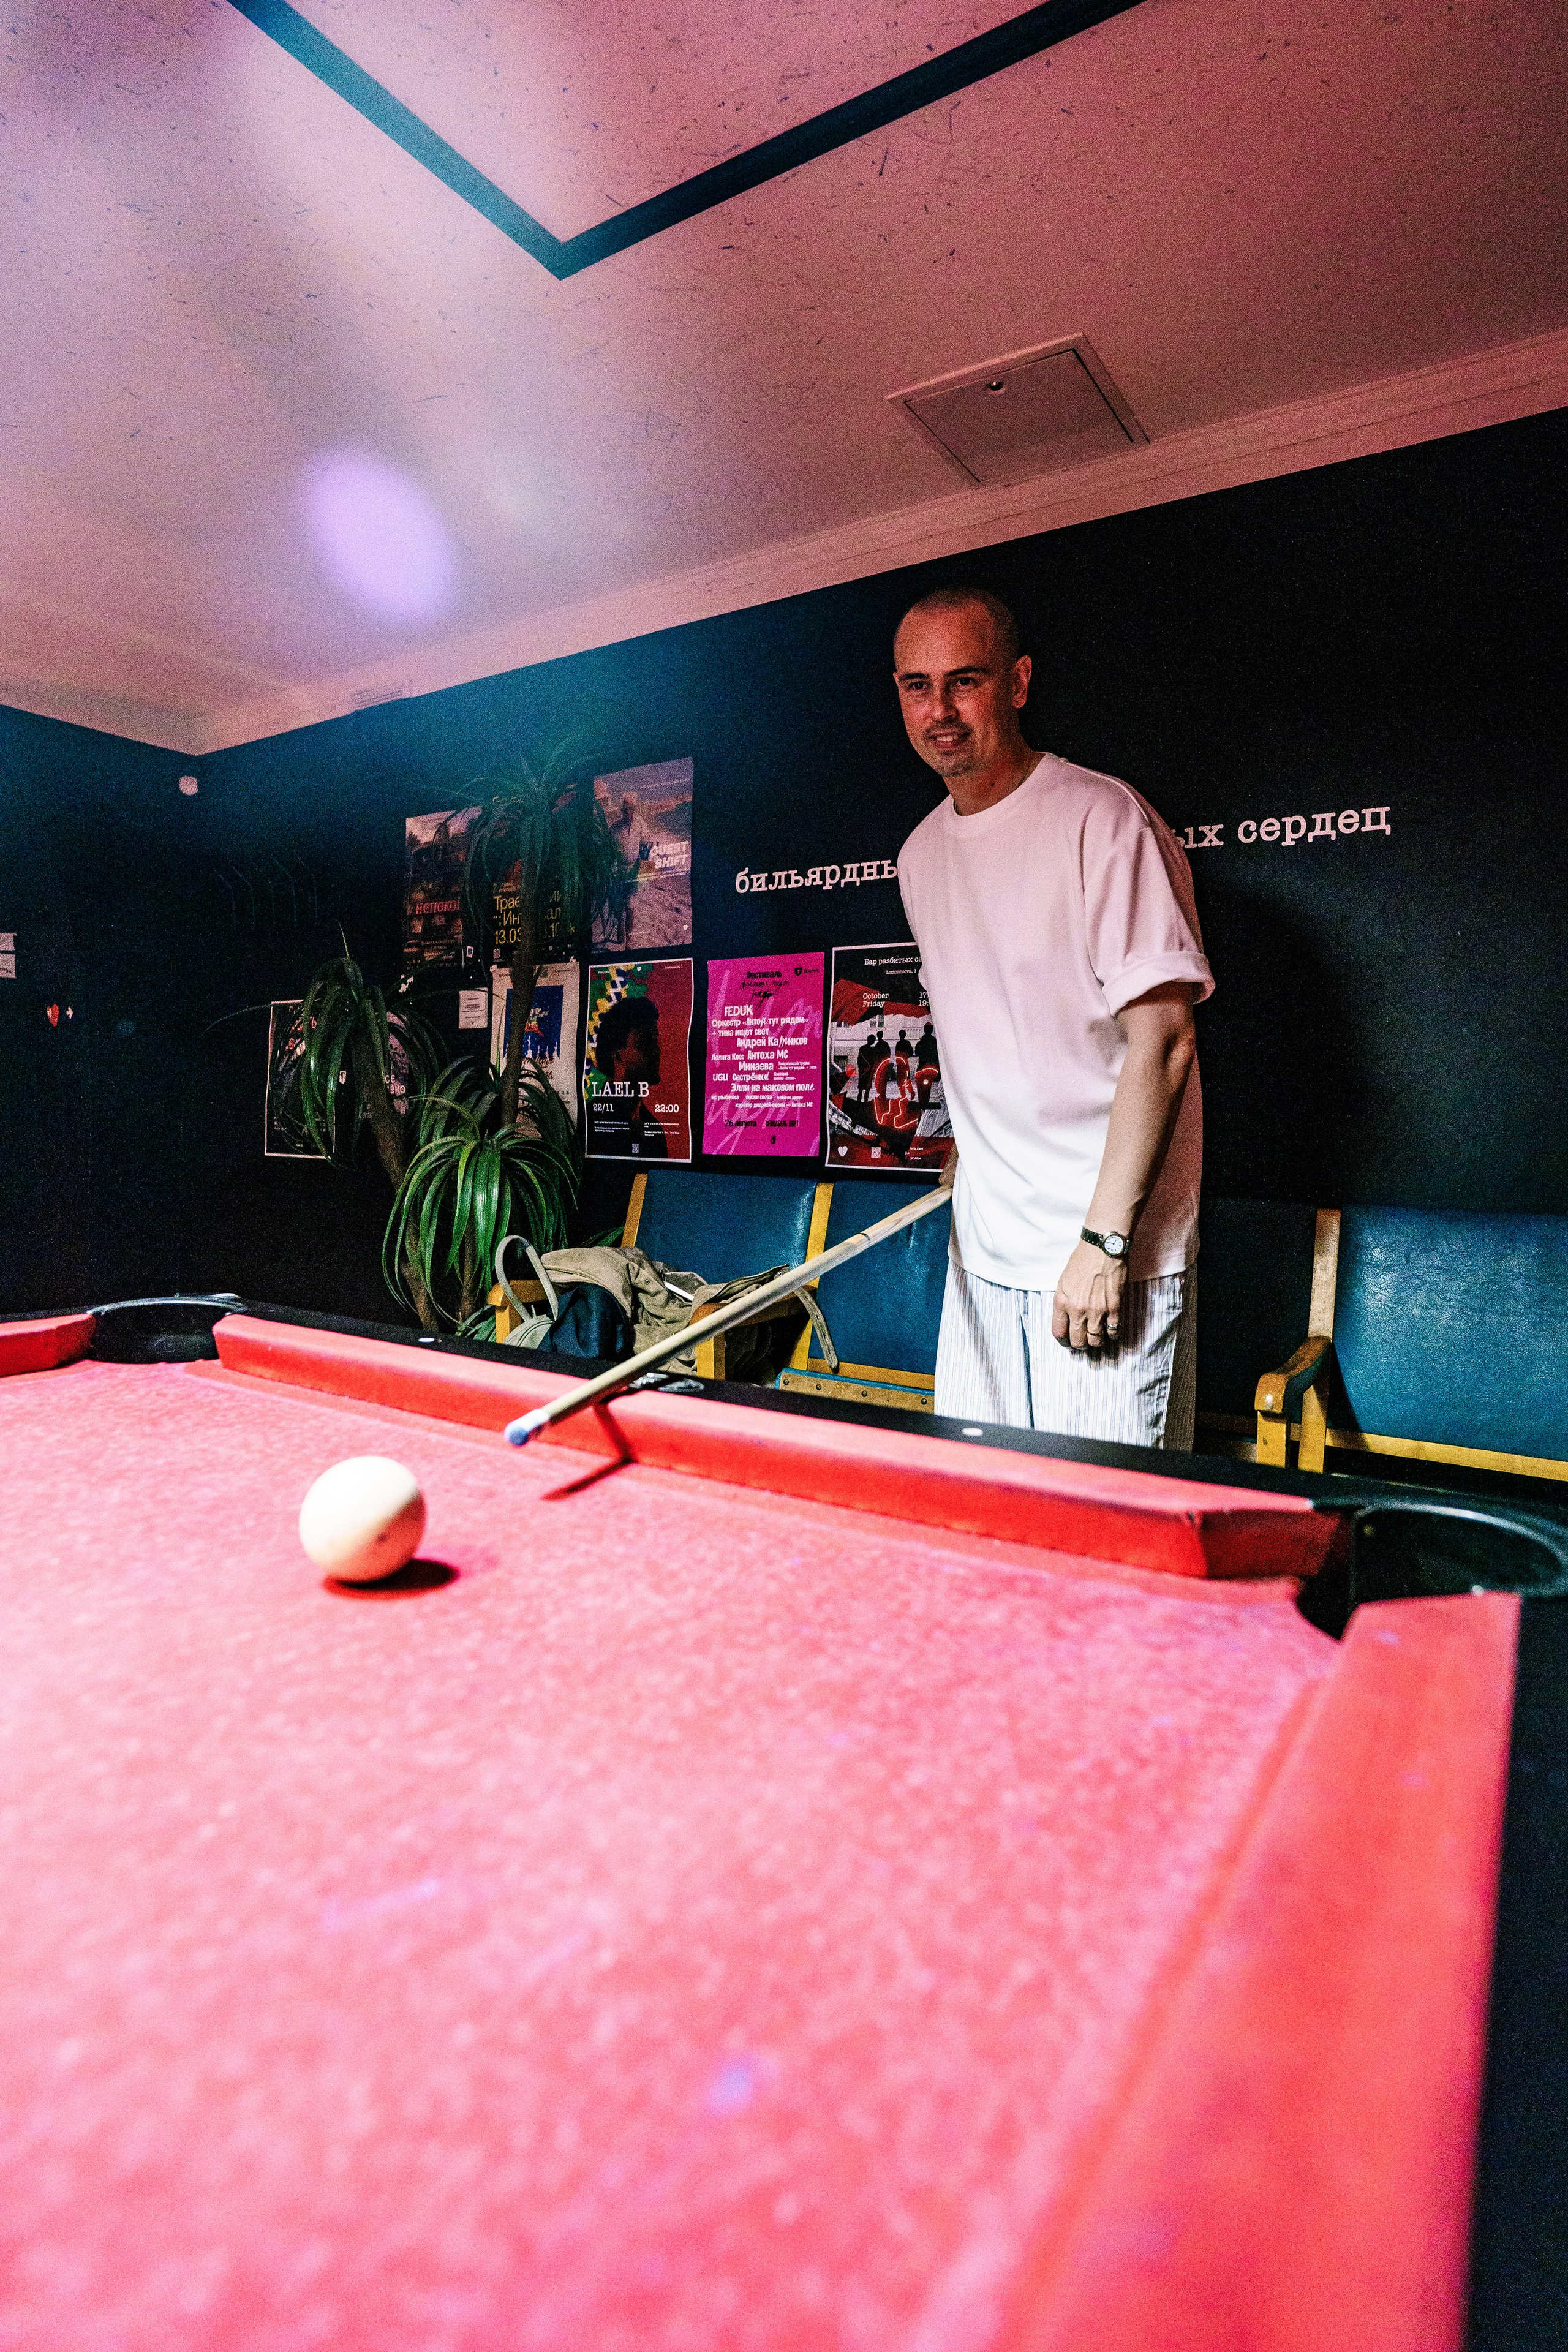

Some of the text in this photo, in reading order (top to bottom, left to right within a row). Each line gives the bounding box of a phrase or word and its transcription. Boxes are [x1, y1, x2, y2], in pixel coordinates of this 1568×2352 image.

[1238, 806, 1391, 846] сердец
[650, 840, 688, 856] GUEST
[655, 854, 688, 869] SHIFT
[878, 957, 913, 966] разбитых
[768, 1017, 779, 1026] тут
[737, 1036, 766, 1049] Андрей
[747, 1050, 775, 1060] Антоха
[739, 1061, 774, 1071] Минаева
[592, 1082, 649, 1097] LAEL B
[731, 1083, 750, 1092] Элли
[593, 1103, 679, 1113] 22/11 22:00
